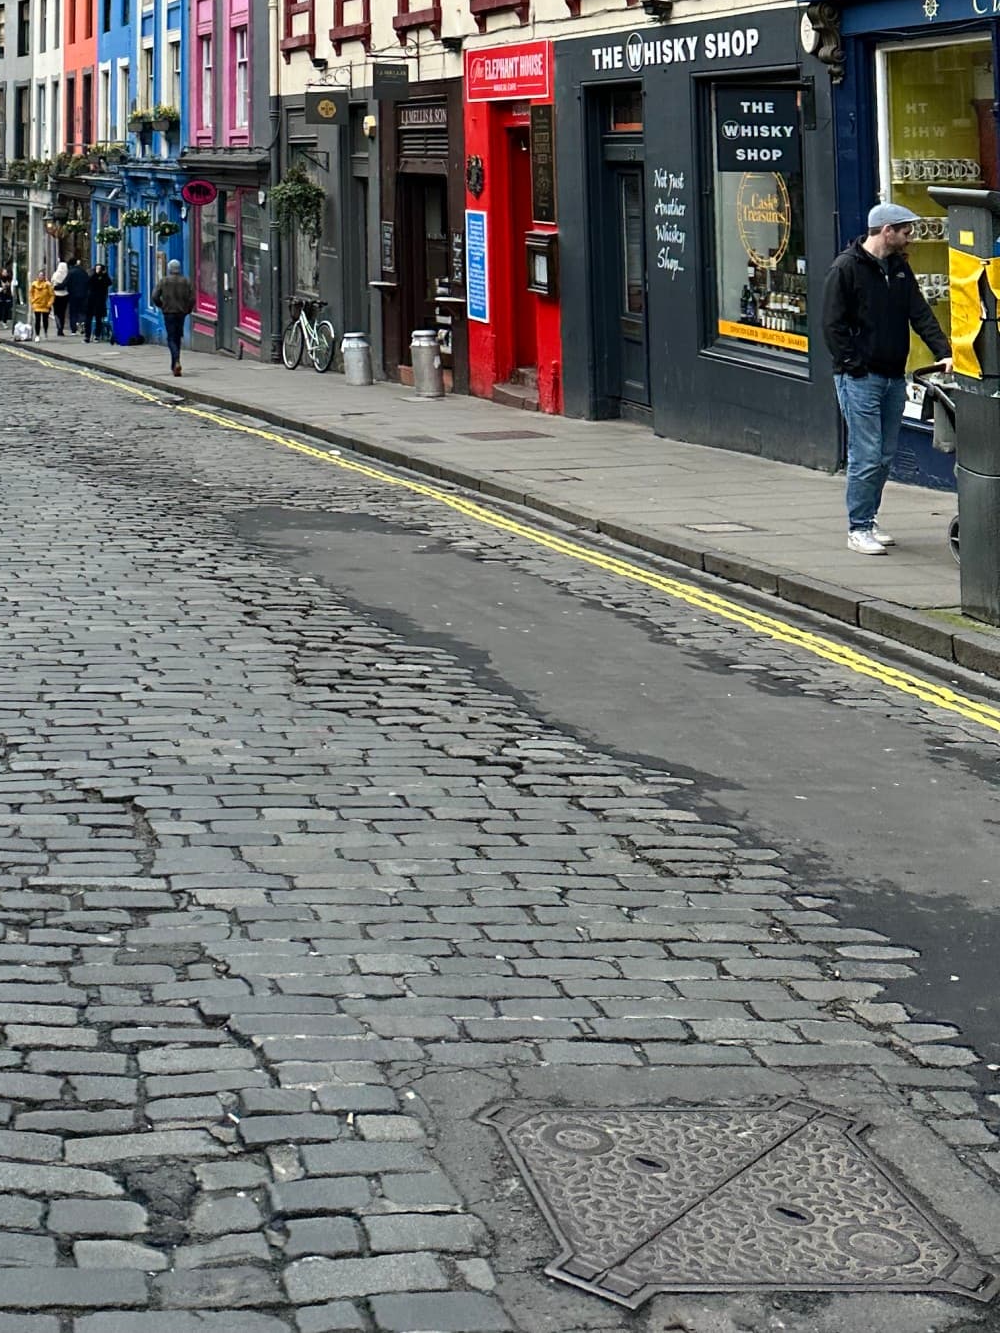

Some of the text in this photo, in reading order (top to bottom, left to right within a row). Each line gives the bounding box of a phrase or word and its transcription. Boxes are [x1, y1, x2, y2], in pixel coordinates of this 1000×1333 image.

[592, 28, 759, 70] THE WHISKY SHOP
[485, 56, 519, 80] ELEPHANT
[519, 53, 543, 76] HOUSE
[740, 101, 775, 114] THE
[723, 123, 794, 138] WHISKY
[735, 148, 783, 161] SHOP
[653, 168, 685, 197] Not Just
[654, 197, 686, 217] Another
[743, 205, 787, 223] Treasures
[655, 222, 685, 252] Whisky
